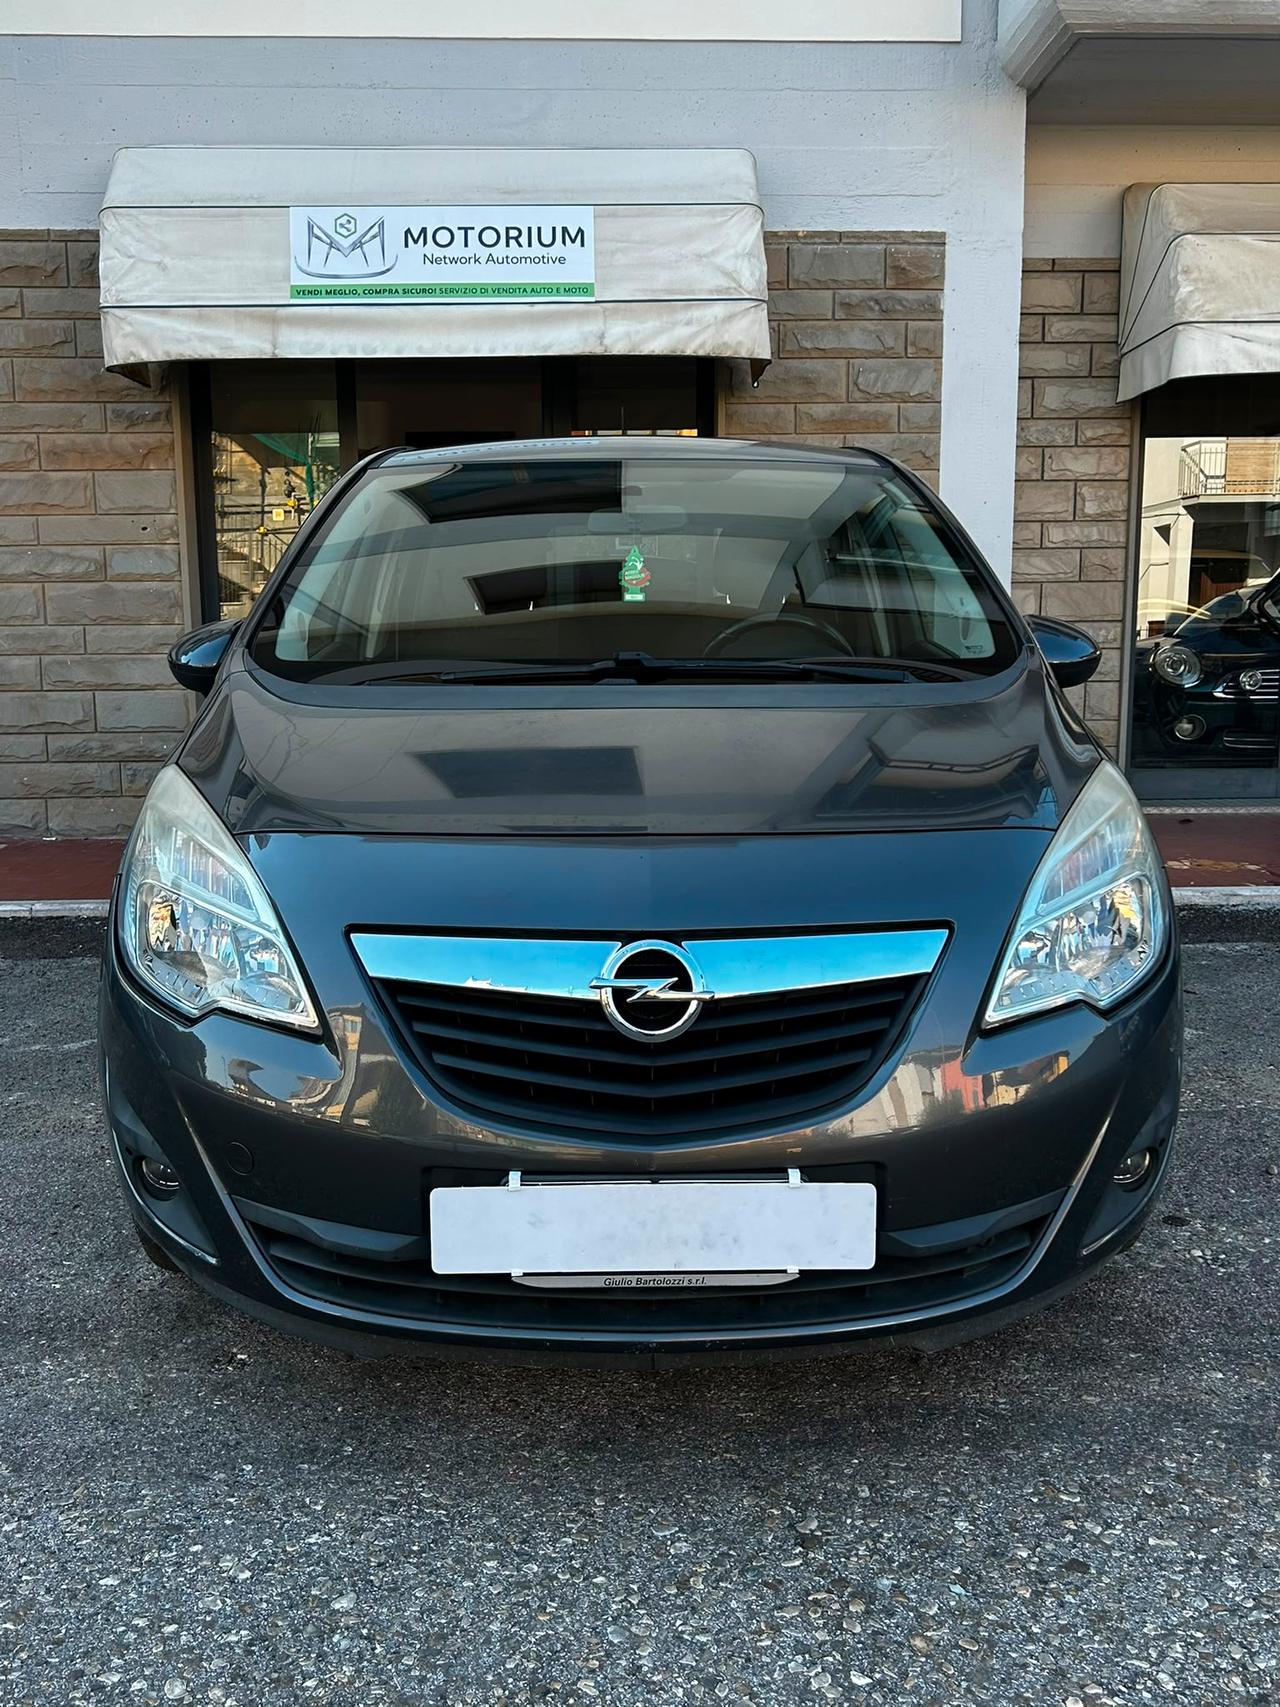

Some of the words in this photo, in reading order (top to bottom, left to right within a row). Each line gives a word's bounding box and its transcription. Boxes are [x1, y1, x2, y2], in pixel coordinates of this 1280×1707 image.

[403, 226, 585, 249] MOTORIUM
[422, 252, 482, 265] Network
[485, 252, 567, 265] Automotive
[295, 288, 323, 296] VENDI
[325, 288, 360, 297] MEGLIO,
[362, 287, 400, 296] COMPRA
[402, 287, 437, 295] SICURO!
[439, 286, 478, 295] SERVIZIO
[480, 286, 489, 295] DI
[491, 286, 528, 295] VENDITA
[530, 286, 554, 294] AUTO
[563, 286, 589, 294] MOTO
[603, 1277, 633, 1287] Giulio
[635, 1277, 685, 1286] Bartolozzi
[687, 1276, 707, 1286] s.r.l.
